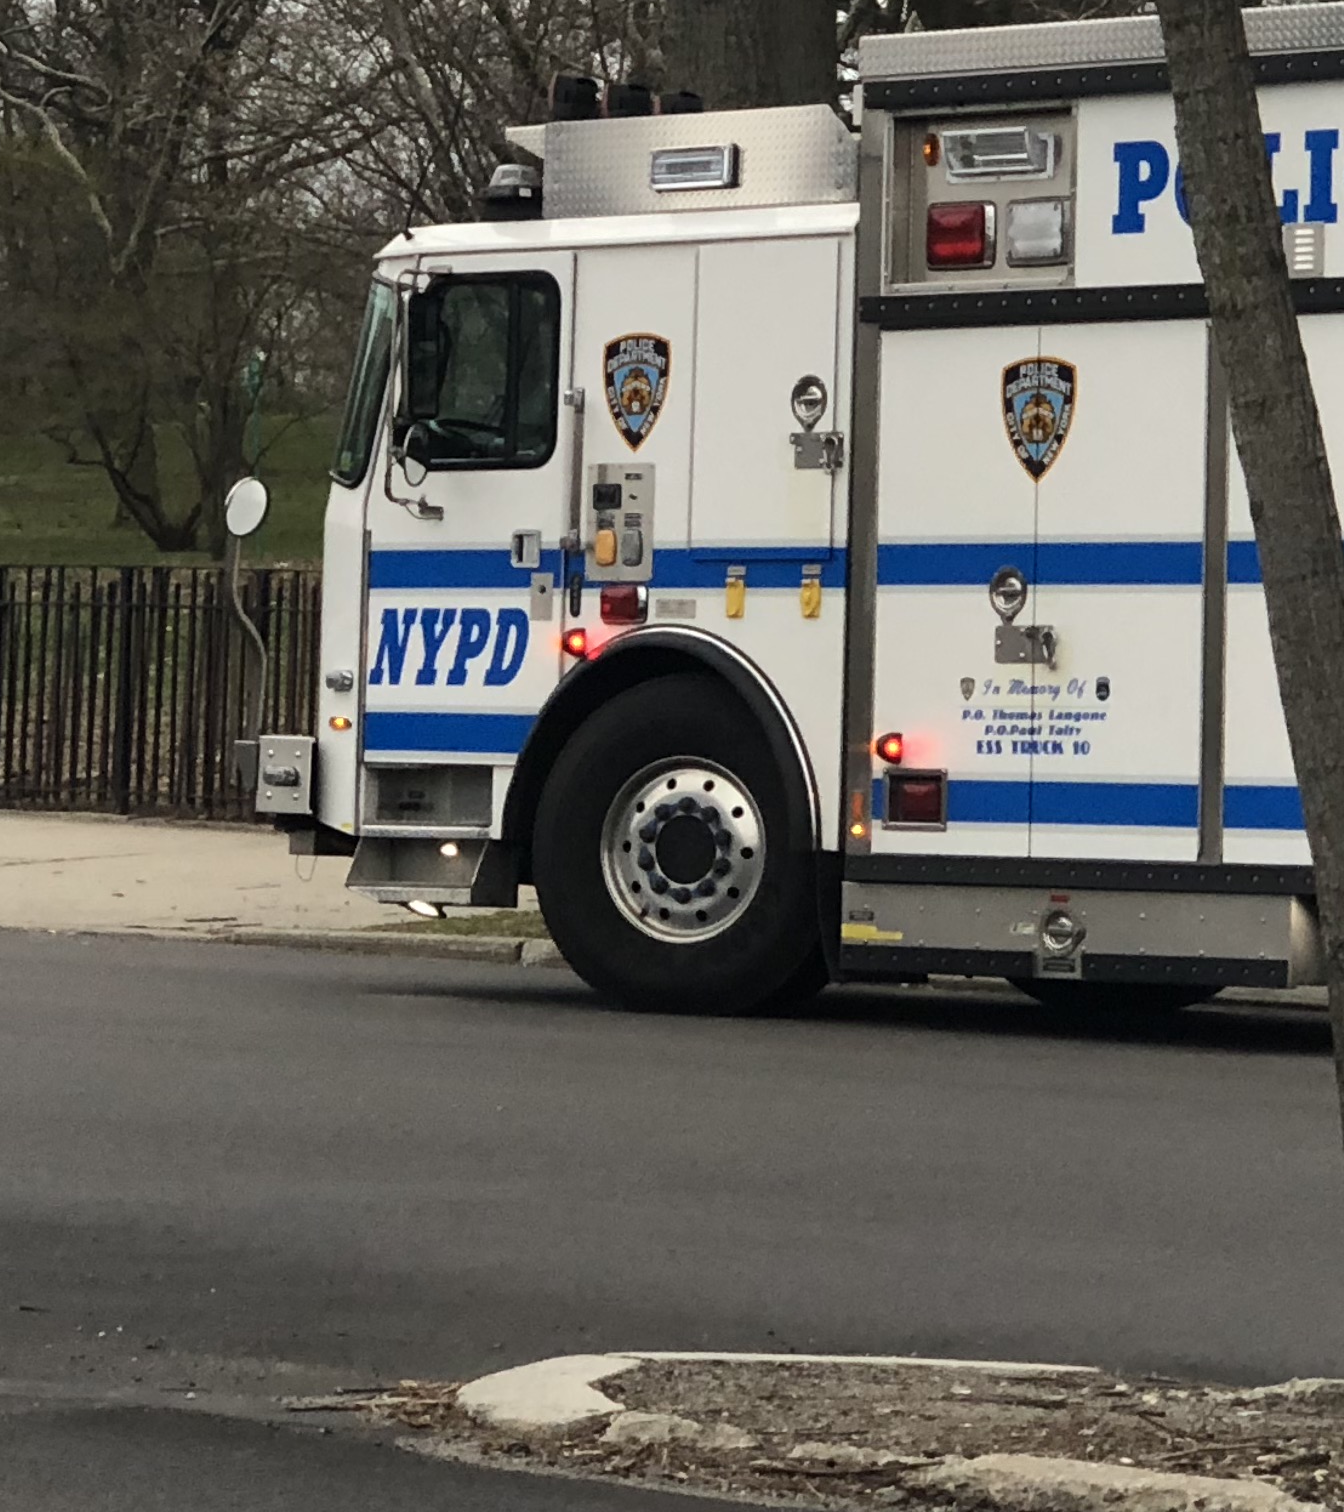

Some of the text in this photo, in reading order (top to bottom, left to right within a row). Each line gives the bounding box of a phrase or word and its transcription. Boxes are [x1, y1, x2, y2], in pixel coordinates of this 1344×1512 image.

[1019, 363, 1059, 377] POLICE
[368, 607, 530, 687] NYPD
[1007, 678, 1061, 701] Memory
[1067, 677, 1087, 698] Of
[992, 709, 1043, 721] Thomas
[1048, 709, 1107, 722] Langone
[976, 740, 1091, 755] ESS TRUCK 10
